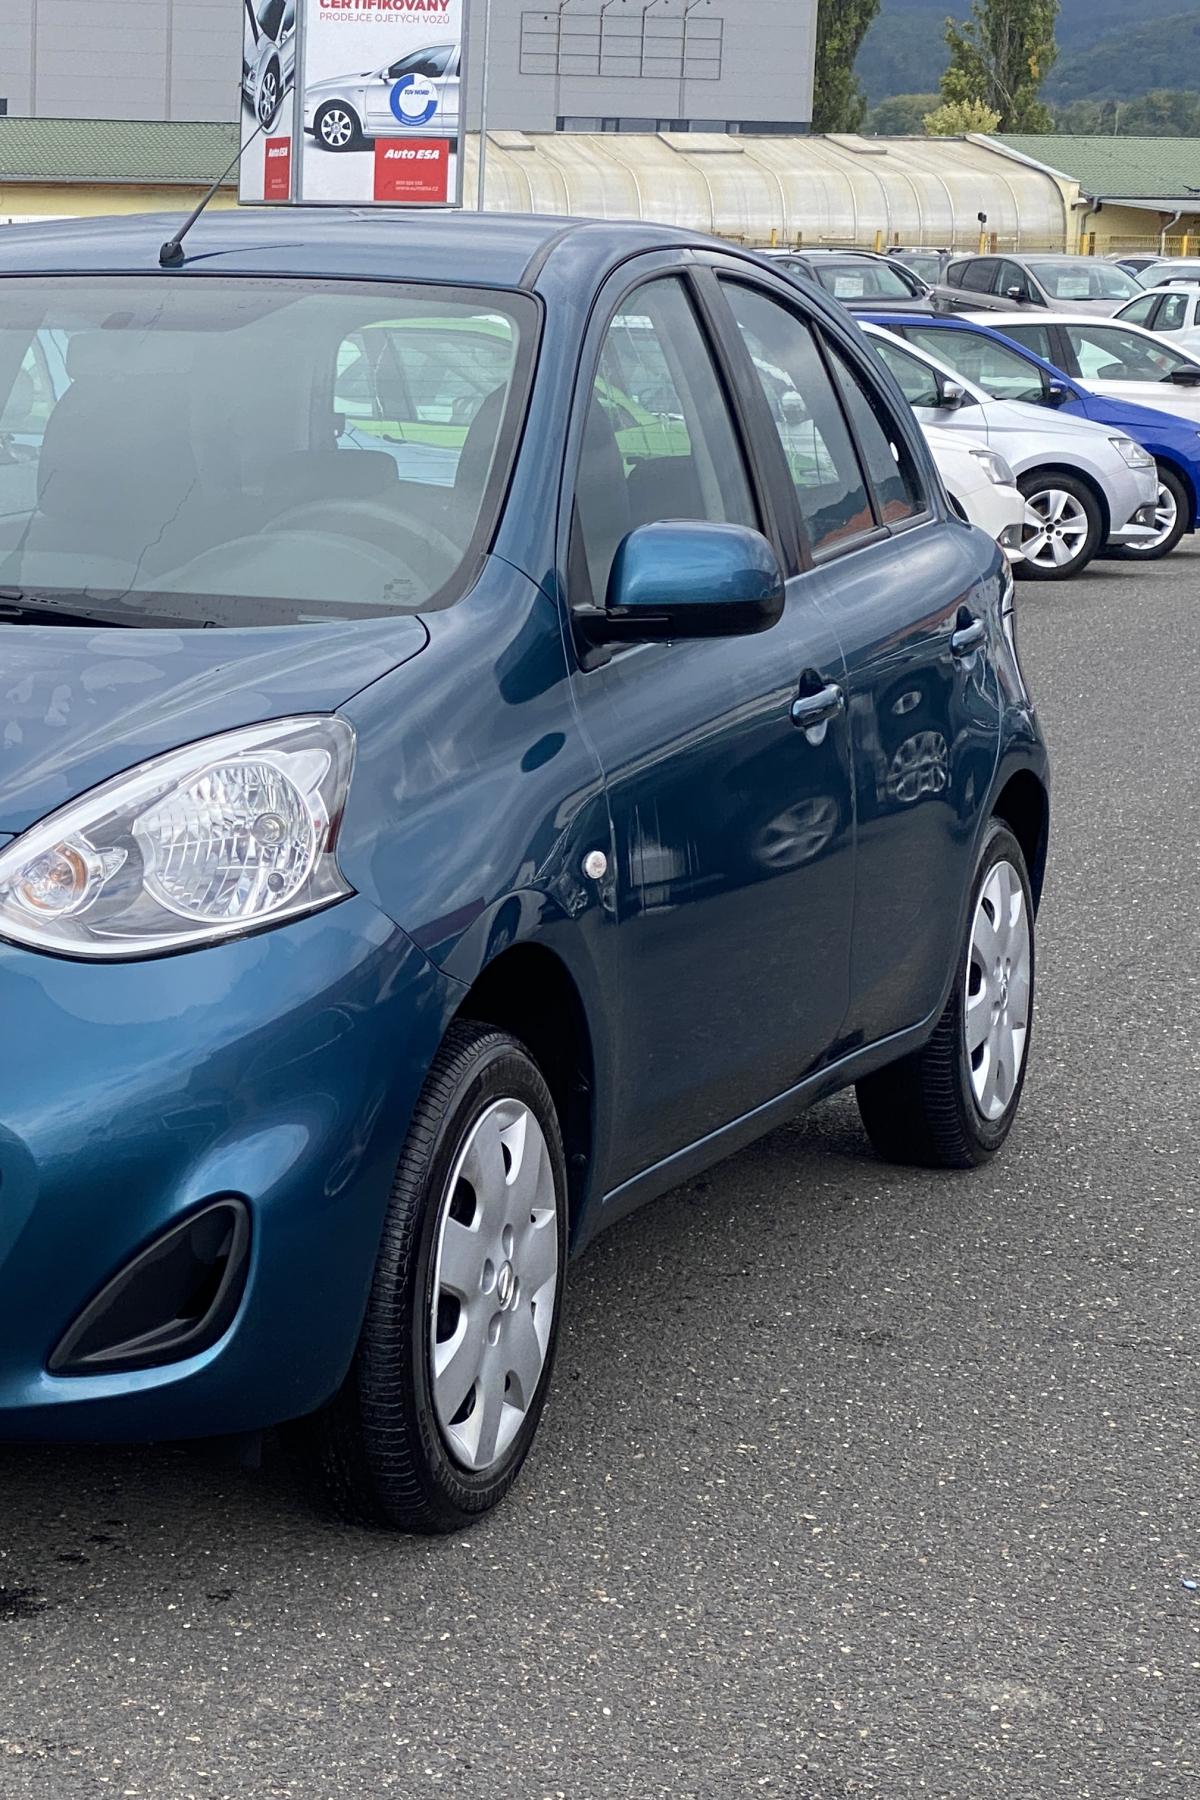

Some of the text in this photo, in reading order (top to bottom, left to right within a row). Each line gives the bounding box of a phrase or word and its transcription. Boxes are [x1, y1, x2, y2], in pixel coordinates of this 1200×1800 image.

[319, 11, 373, 23] PRODEJCE
[374, 12, 420, 24] OJETÝCH
[383, 148, 440, 160] Auto ESA
